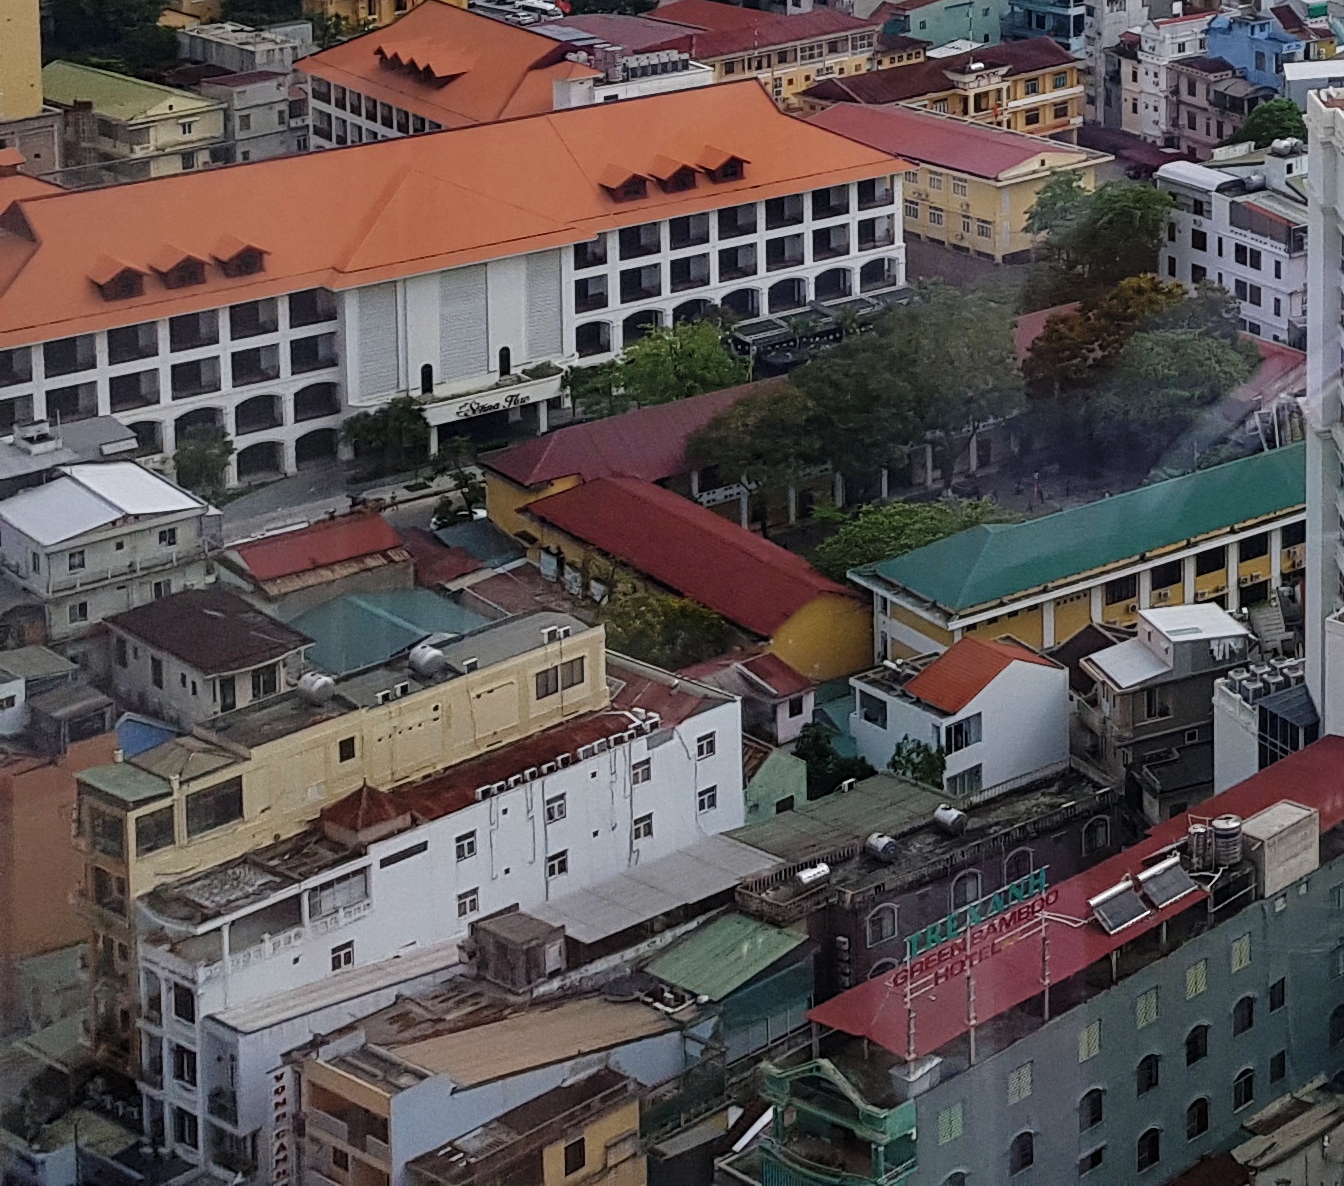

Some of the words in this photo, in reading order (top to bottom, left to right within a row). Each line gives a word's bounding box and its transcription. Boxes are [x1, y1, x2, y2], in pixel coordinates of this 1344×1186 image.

[892, 937, 968, 988] GREEN
[970, 889, 1059, 946] BAMBOO
[933, 941, 1003, 987] HOTEL
